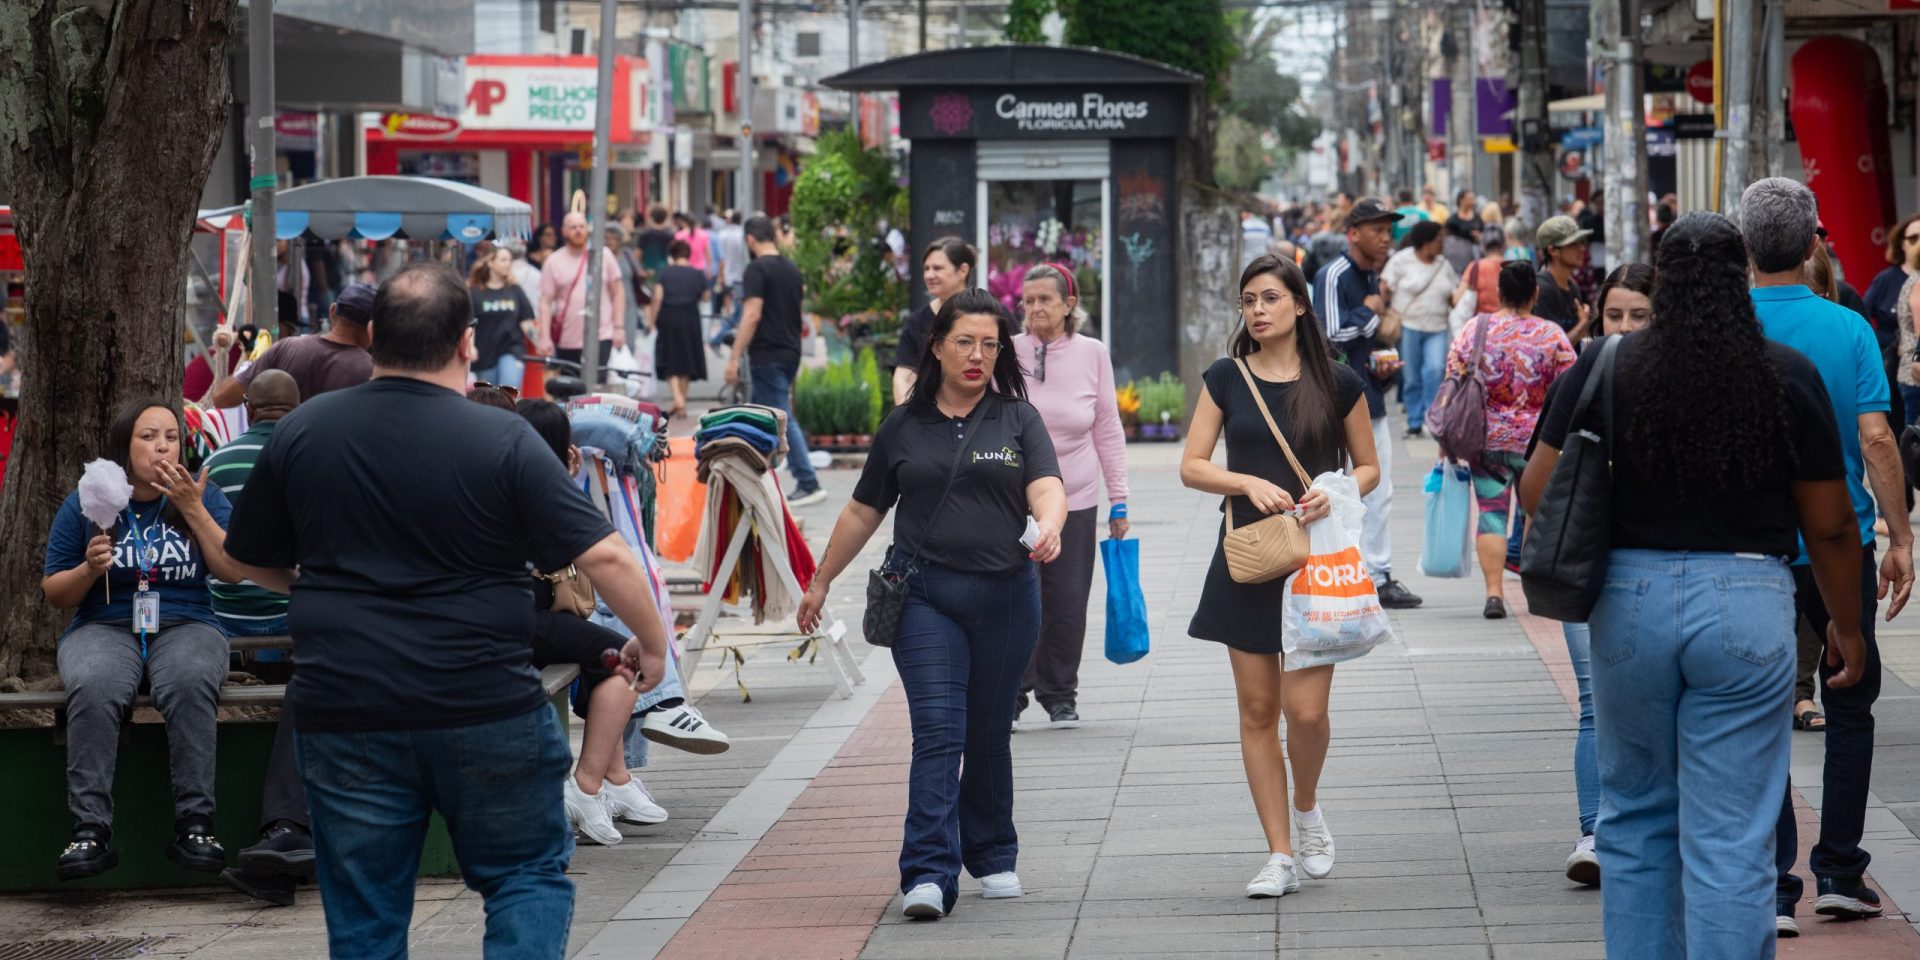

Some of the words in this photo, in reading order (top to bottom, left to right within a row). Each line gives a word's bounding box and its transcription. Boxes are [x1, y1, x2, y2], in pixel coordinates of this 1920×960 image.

[528, 105, 587, 124] PREÇO
[995, 93, 1077, 119] Carmen
[1082, 92, 1149, 119] Flores
[1018, 118, 1126, 130] FLORICULTURA
[976, 452, 1013, 461] LUNA
[162, 562, 197, 581] TIM
[1305, 560, 1369, 587] TORRA
